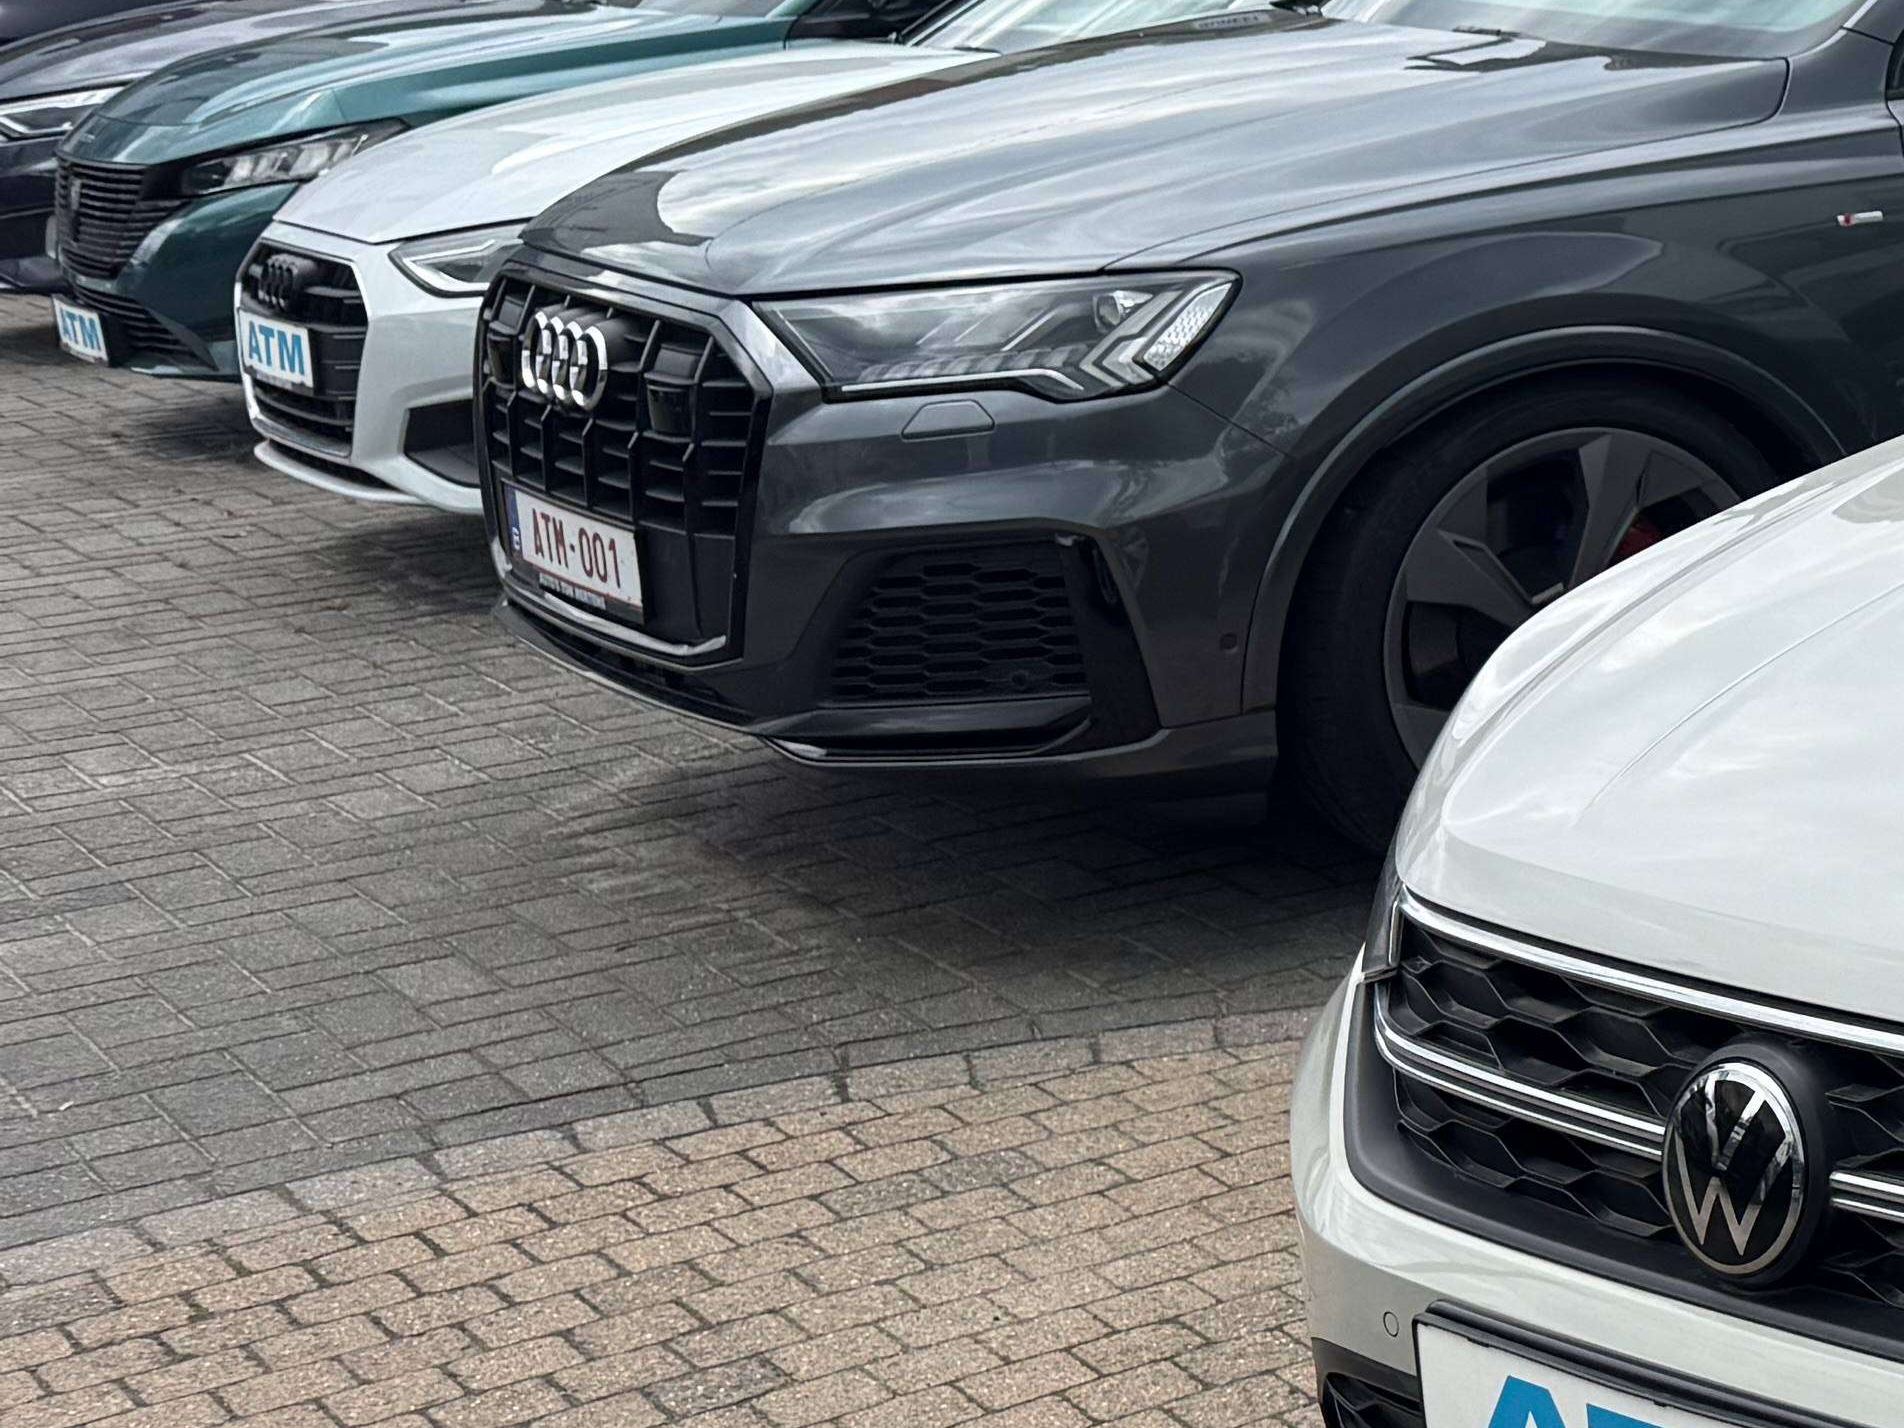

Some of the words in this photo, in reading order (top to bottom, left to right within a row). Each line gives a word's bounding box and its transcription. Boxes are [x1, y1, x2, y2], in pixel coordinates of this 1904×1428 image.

[60, 307, 102, 352] ATM
[248, 320, 305, 375] ATM
[532, 508, 621, 589] ATM-001
